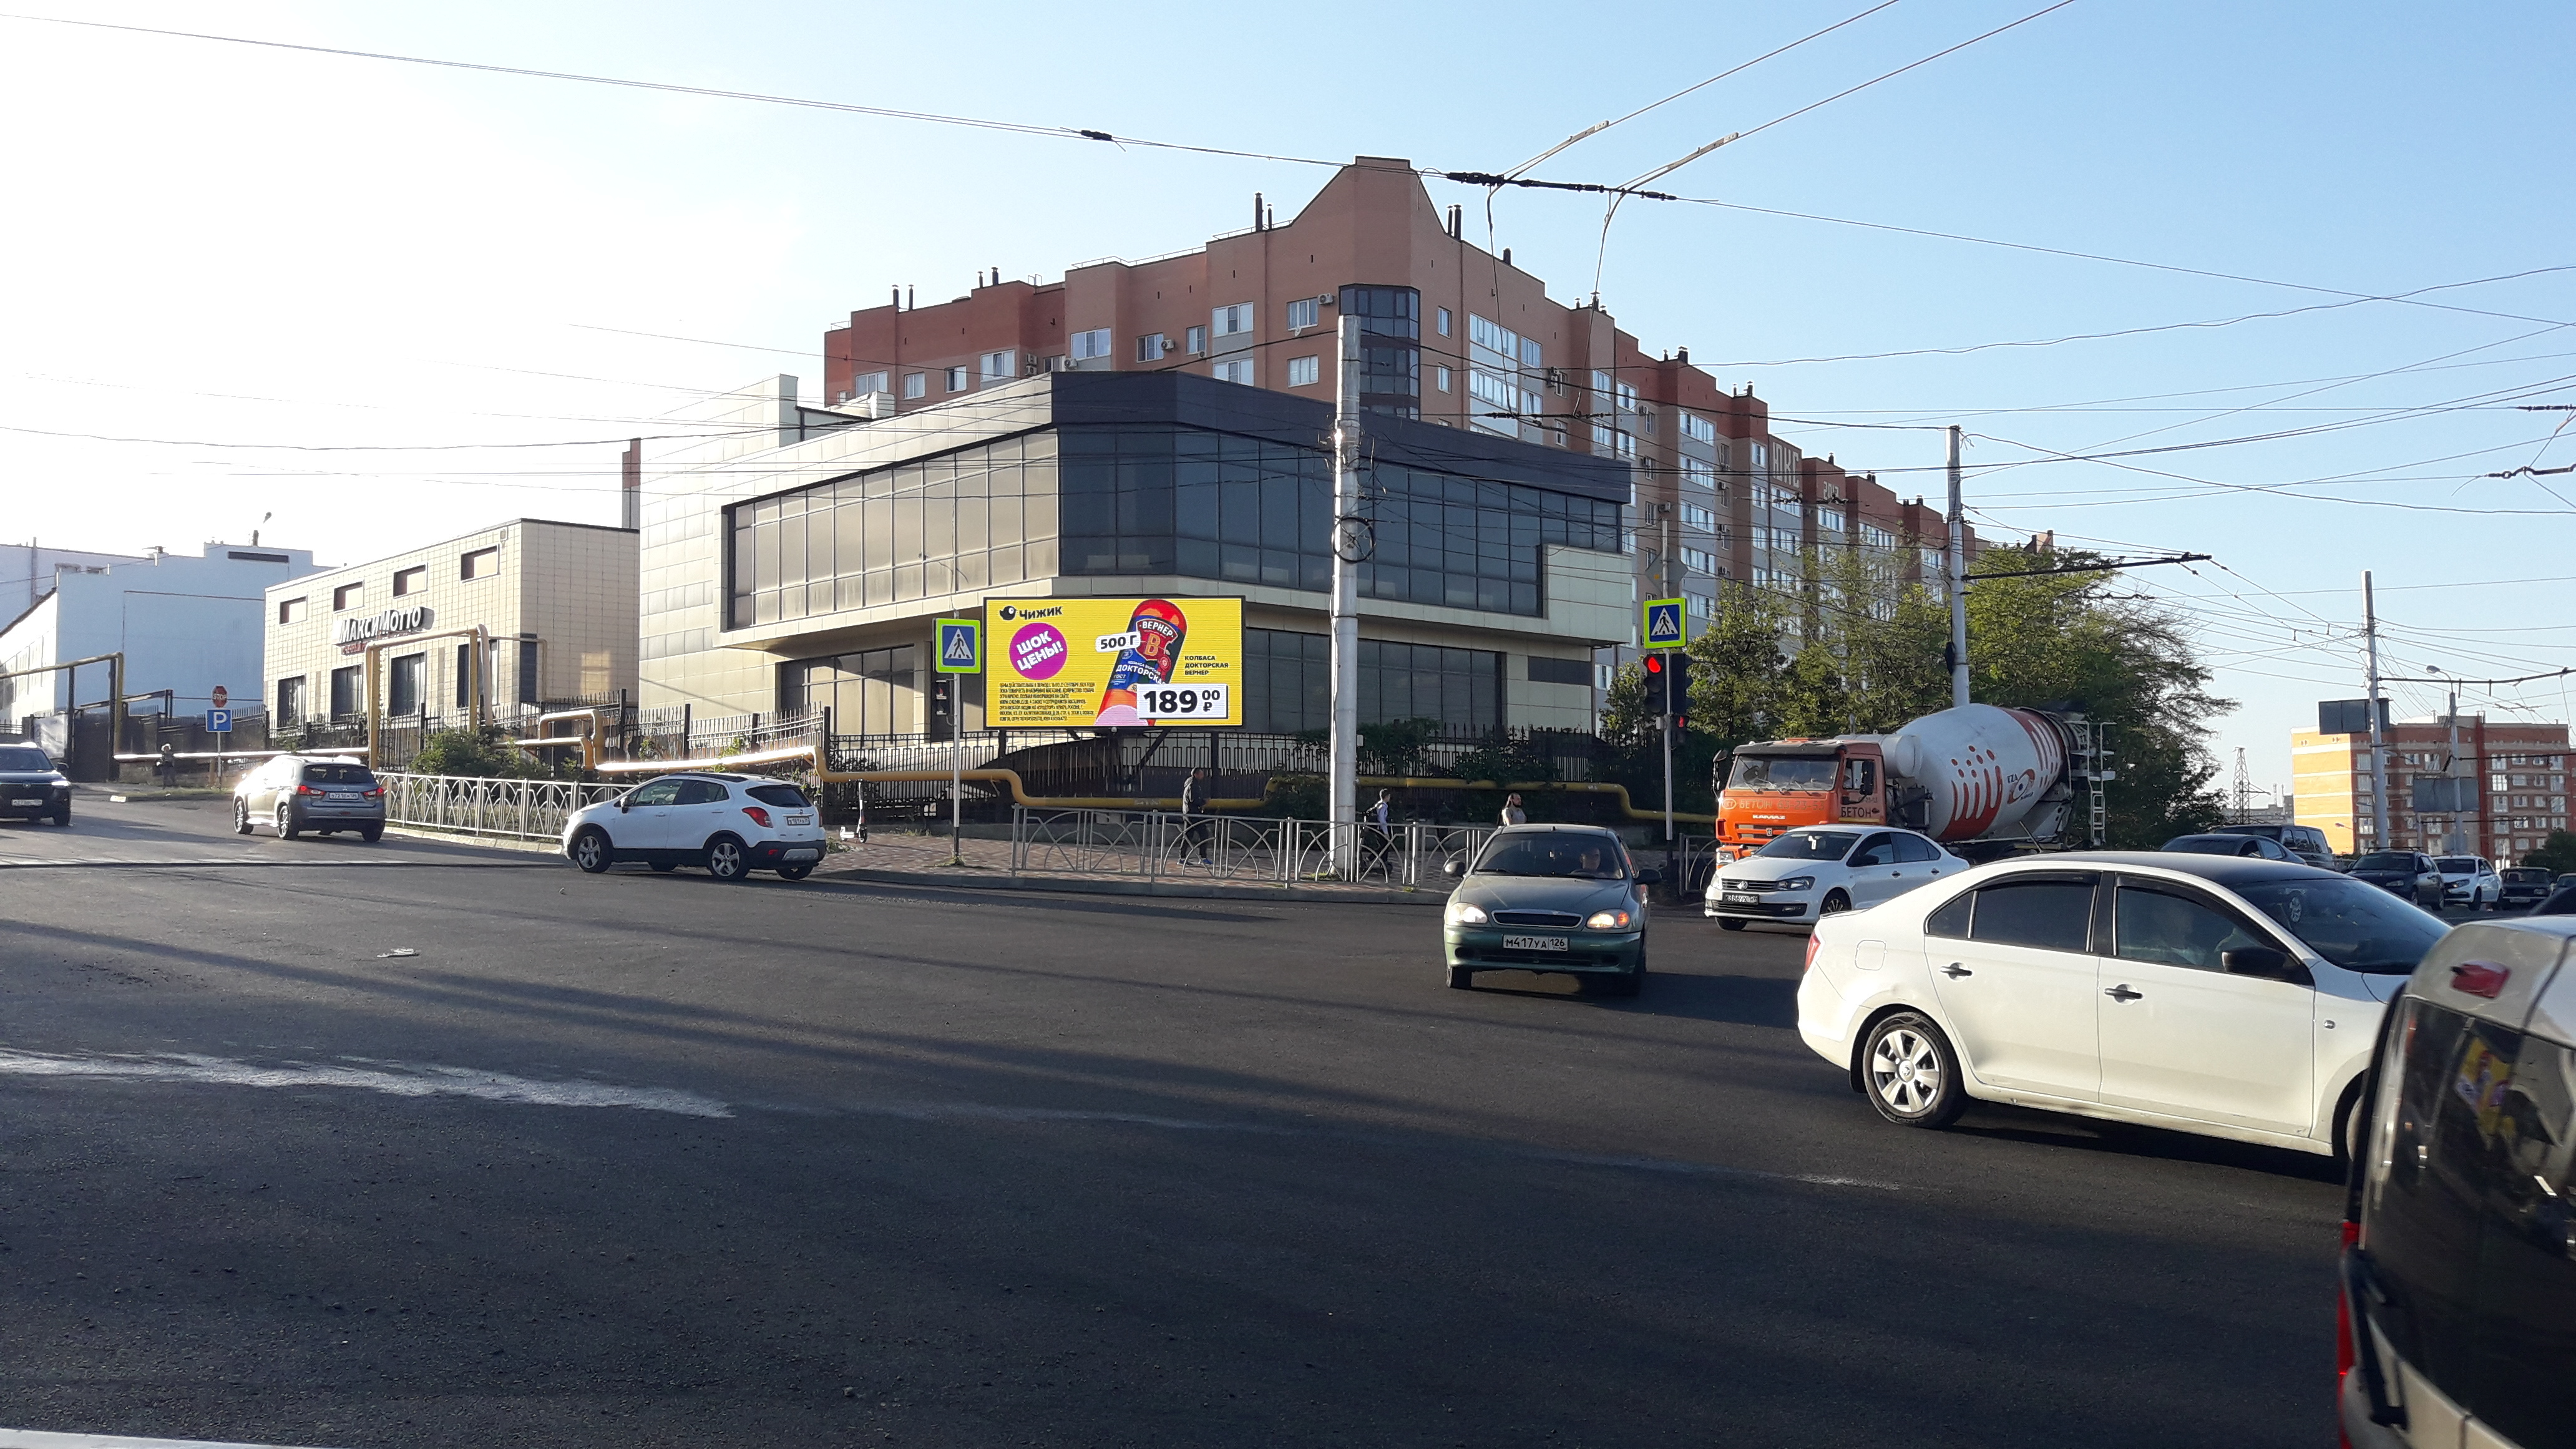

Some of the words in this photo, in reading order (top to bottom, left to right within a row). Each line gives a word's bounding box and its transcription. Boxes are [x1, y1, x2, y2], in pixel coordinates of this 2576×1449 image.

[1019, 606, 1063, 620] Чижик
[1142, 621, 1173, 637] ВЕРНЕР
[1016, 630, 1053, 655] ШОК
[1100, 637, 1126, 649] 500
[1017, 641, 1064, 671] ЦЕНЫ!
[1143, 690, 1198, 713] 189
[1201, 690, 1221, 700] 00
[1739, 799, 1772, 809] БЕТОН
[1841, 806, 1871, 818] БЕТОН
[1506, 937, 1547, 949] М417УА
[1549, 938, 1565, 947] 126
